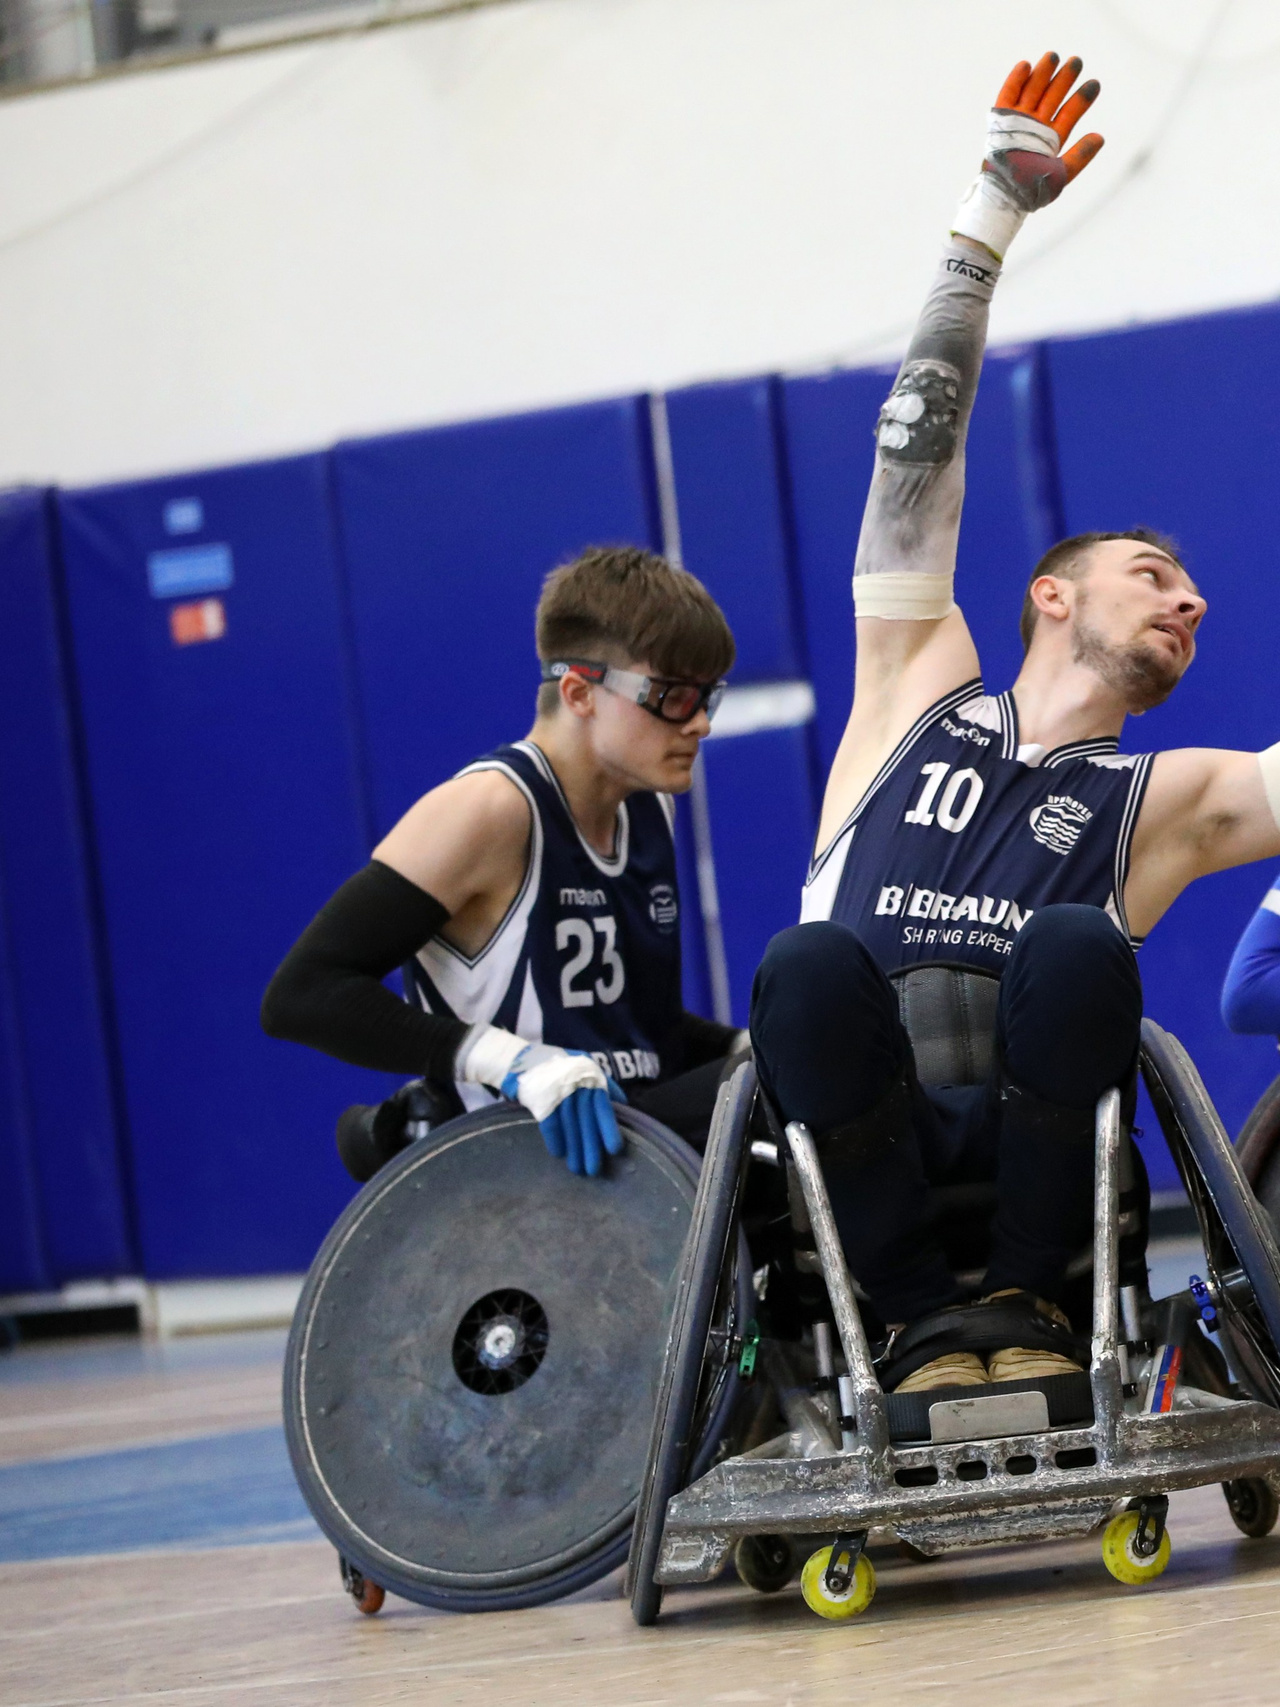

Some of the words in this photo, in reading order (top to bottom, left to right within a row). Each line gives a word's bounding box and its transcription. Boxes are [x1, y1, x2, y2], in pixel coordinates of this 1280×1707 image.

[904, 761, 985, 833] 10
[555, 915, 625, 1009] 23
[902, 926, 963, 945] SHRING
[966, 930, 1014, 956] EXPER
